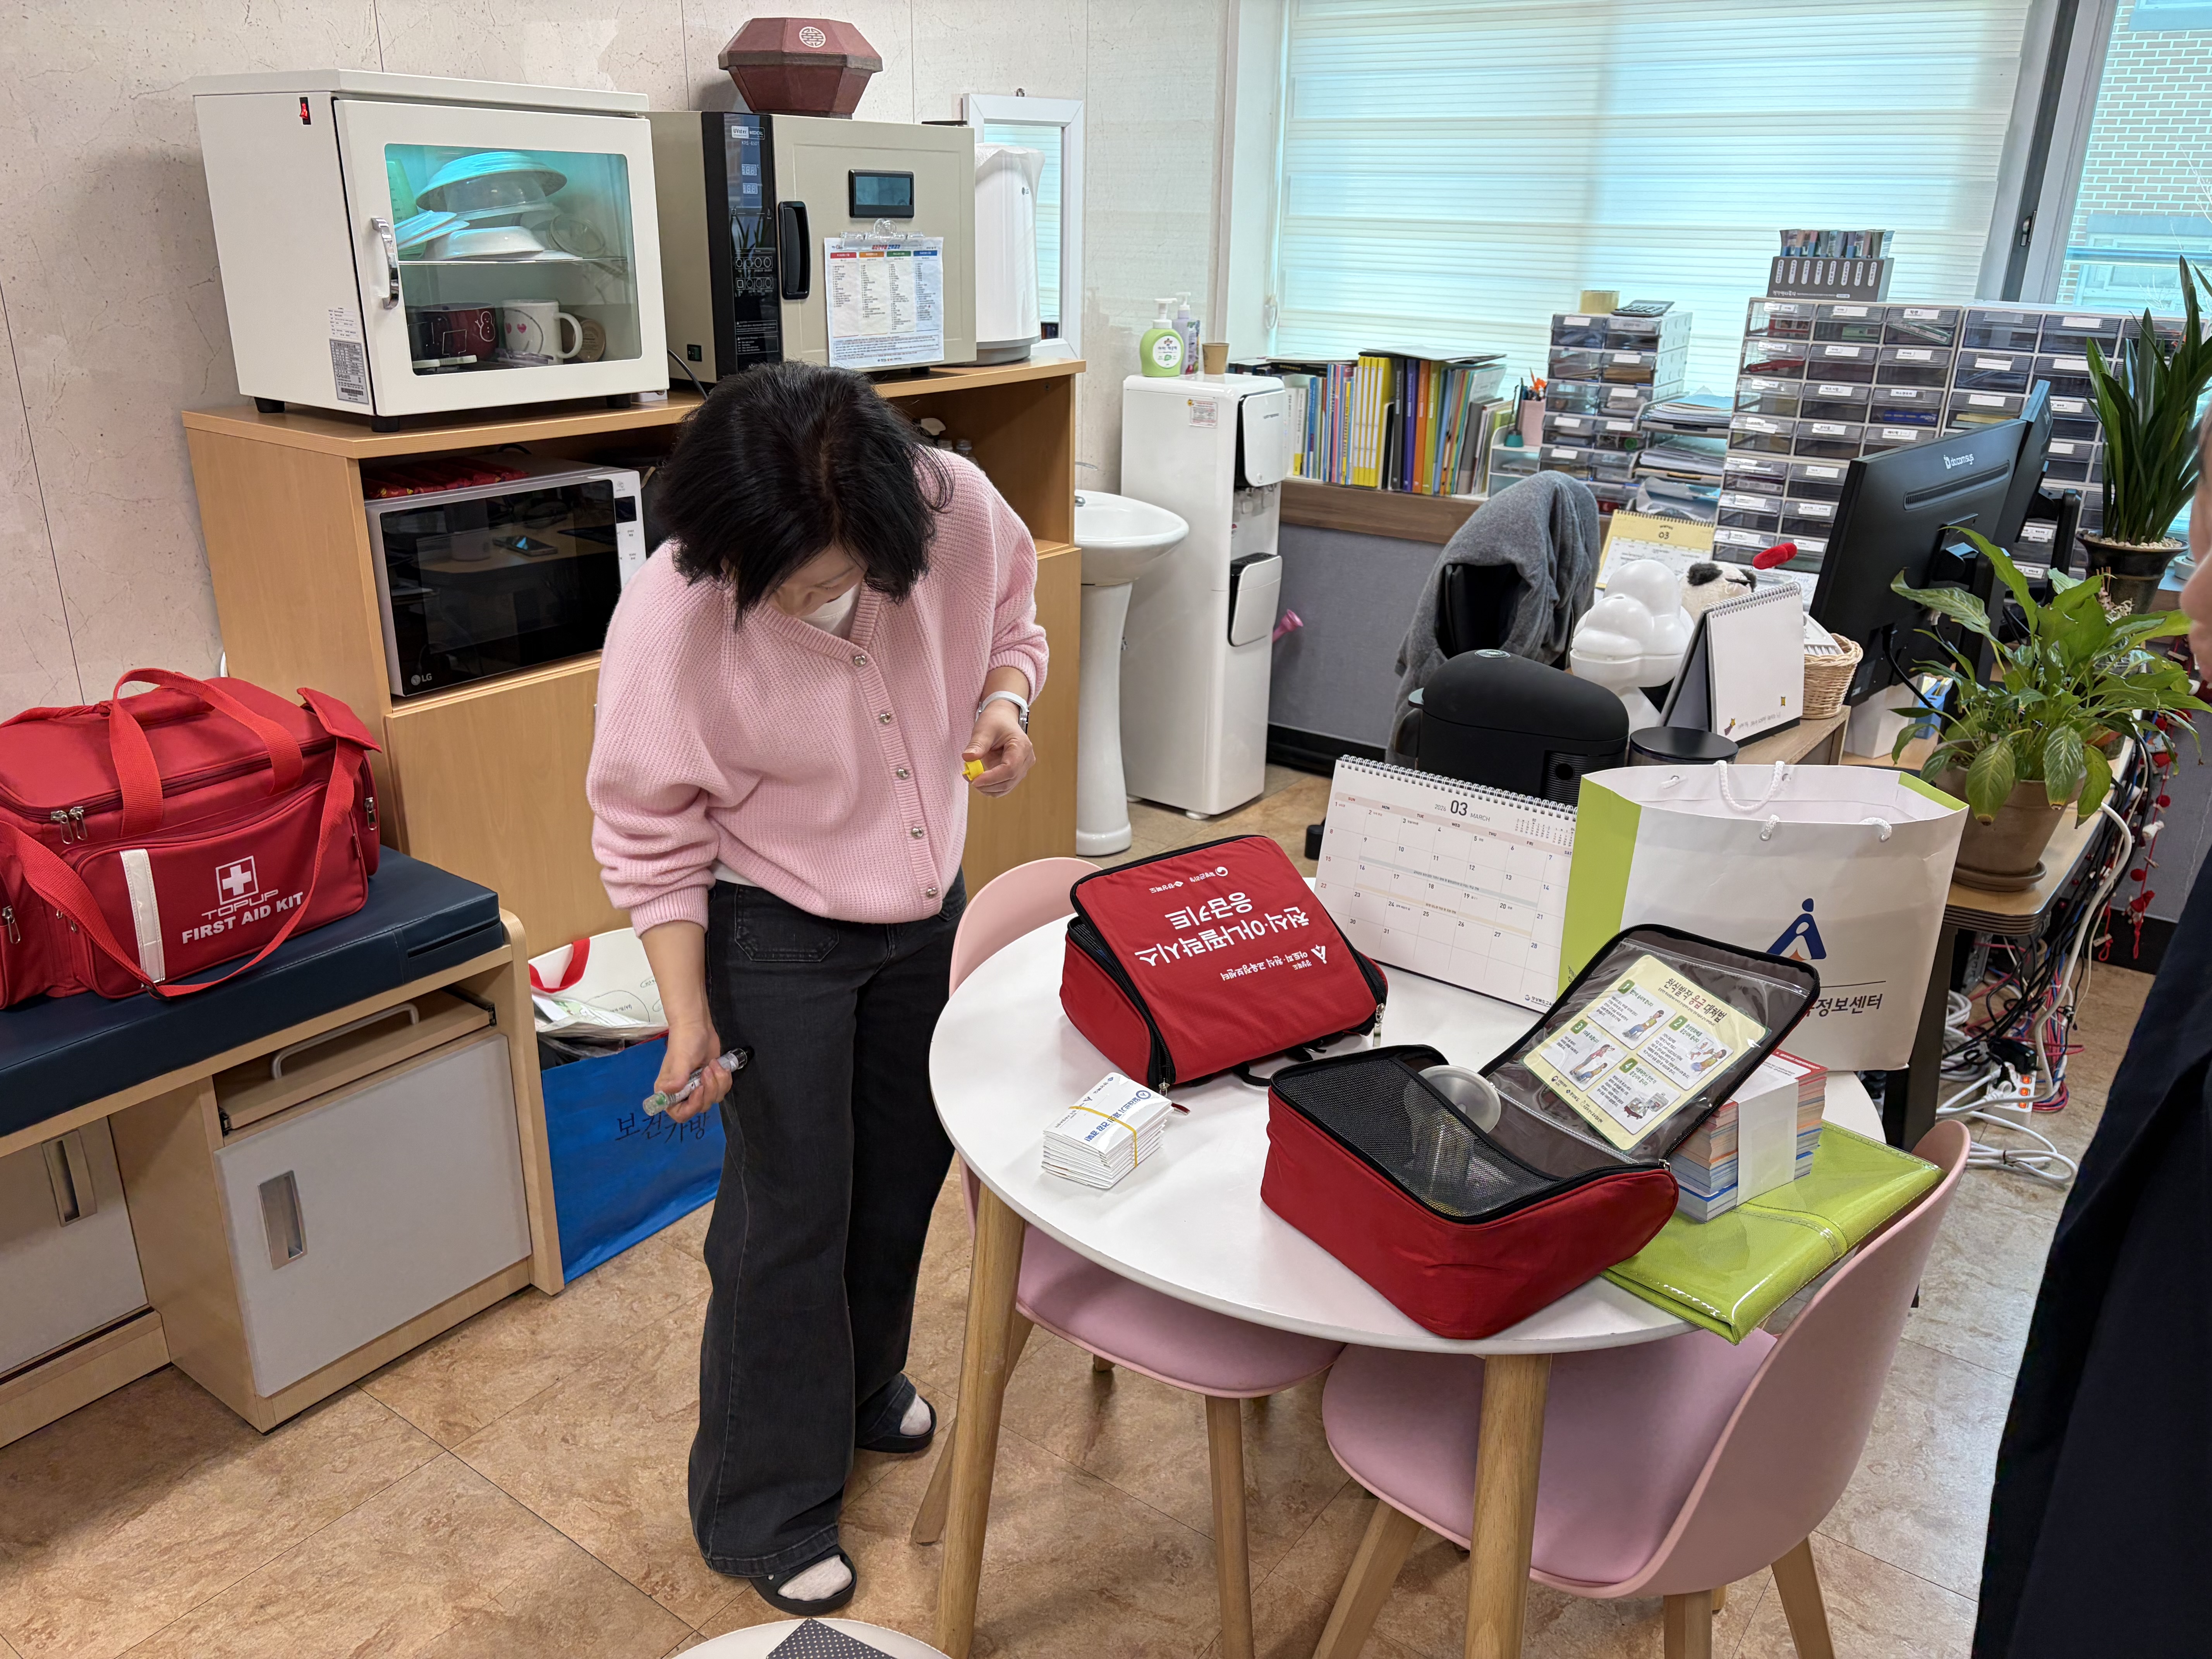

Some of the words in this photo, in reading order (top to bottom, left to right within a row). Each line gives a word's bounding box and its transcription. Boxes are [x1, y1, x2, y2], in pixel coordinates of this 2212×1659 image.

[1659, 531, 1670, 539] 03
[422, 673, 432, 682] LG
[1450, 800, 1468, 816] 03
[1470, 813, 1490, 822] MARCH
[182, 916, 236, 944] FIRST
[241, 905, 271, 925] AID
[276, 891, 304, 913] KIT
[201, 889, 279, 920] TOPUP
[1164, 892, 1253, 930] 응급키트
[1134, 906, 1310, 967] 천식·아나필락시스
[1220, 961, 1266, 981] 교육정보센터
[1664, 978, 1693, 1001] 천식발작
[1689, 995, 1706, 1010] 응급
[1703, 1004, 1728, 1023] 대처법
[1674, 1019, 1682, 1027] 2
[615, 1112, 711, 1144] 보건가방
[1096, 1121, 1110, 1132] 건강
